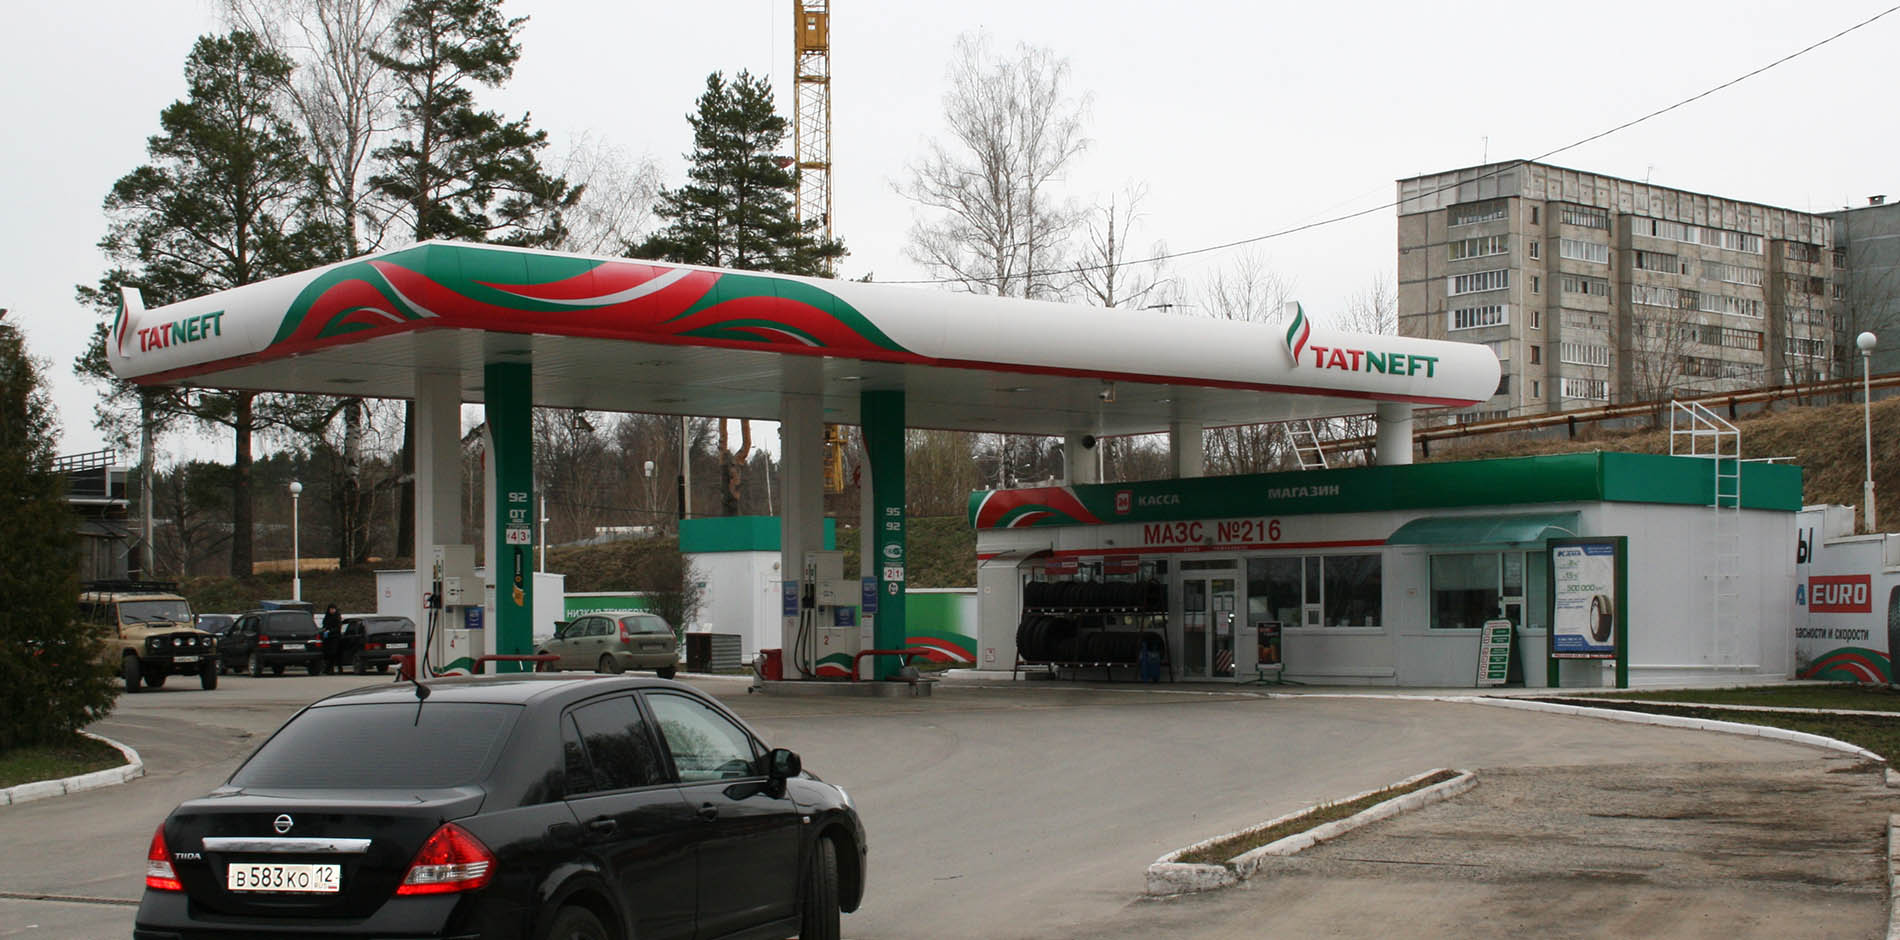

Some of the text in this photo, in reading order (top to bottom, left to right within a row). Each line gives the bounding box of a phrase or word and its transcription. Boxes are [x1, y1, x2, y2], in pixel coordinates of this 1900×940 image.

[137, 311, 224, 352] TATNEFT
[1310, 345, 1439, 378] TATNEFT
[508, 492, 528, 502] 92
[1138, 494, 1180, 506] КАССА
[1268, 484, 1340, 500] МАГАЗИН
[886, 522, 901, 531] 92
[1144, 519, 1282, 545] МАЗС №216
[1812, 583, 1867, 605] EURO
[1834, 627, 1869, 643] скорости
[175, 852, 202, 861] TIIDA
[316, 866, 333, 882] 12
